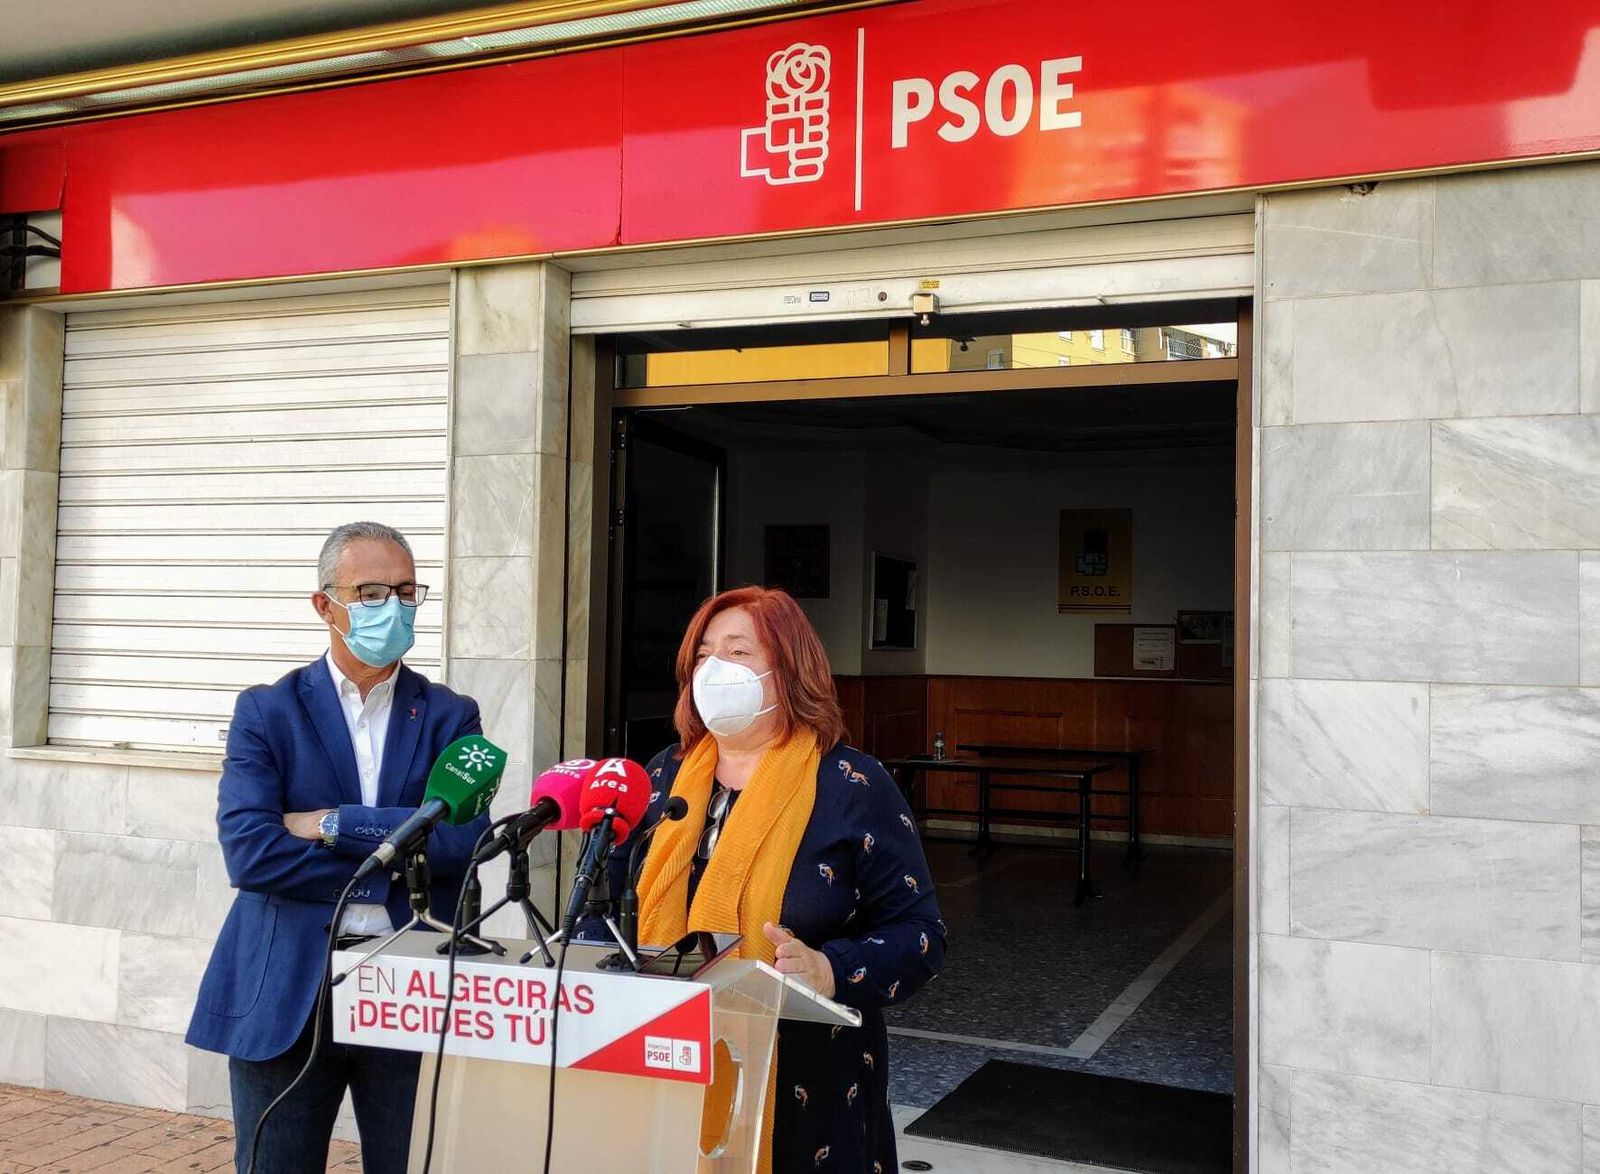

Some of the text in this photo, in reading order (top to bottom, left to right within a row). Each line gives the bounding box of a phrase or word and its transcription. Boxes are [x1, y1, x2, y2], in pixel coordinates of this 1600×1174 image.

[891, 56, 1083, 149] PSOE
[1071, 586, 1121, 596] P.S.O.E.
[358, 965, 594, 1015] EN ALGECIRAS
[349, 999, 494, 1040] ¡DECIDES
[647, 1051, 671, 1063] PSOE
